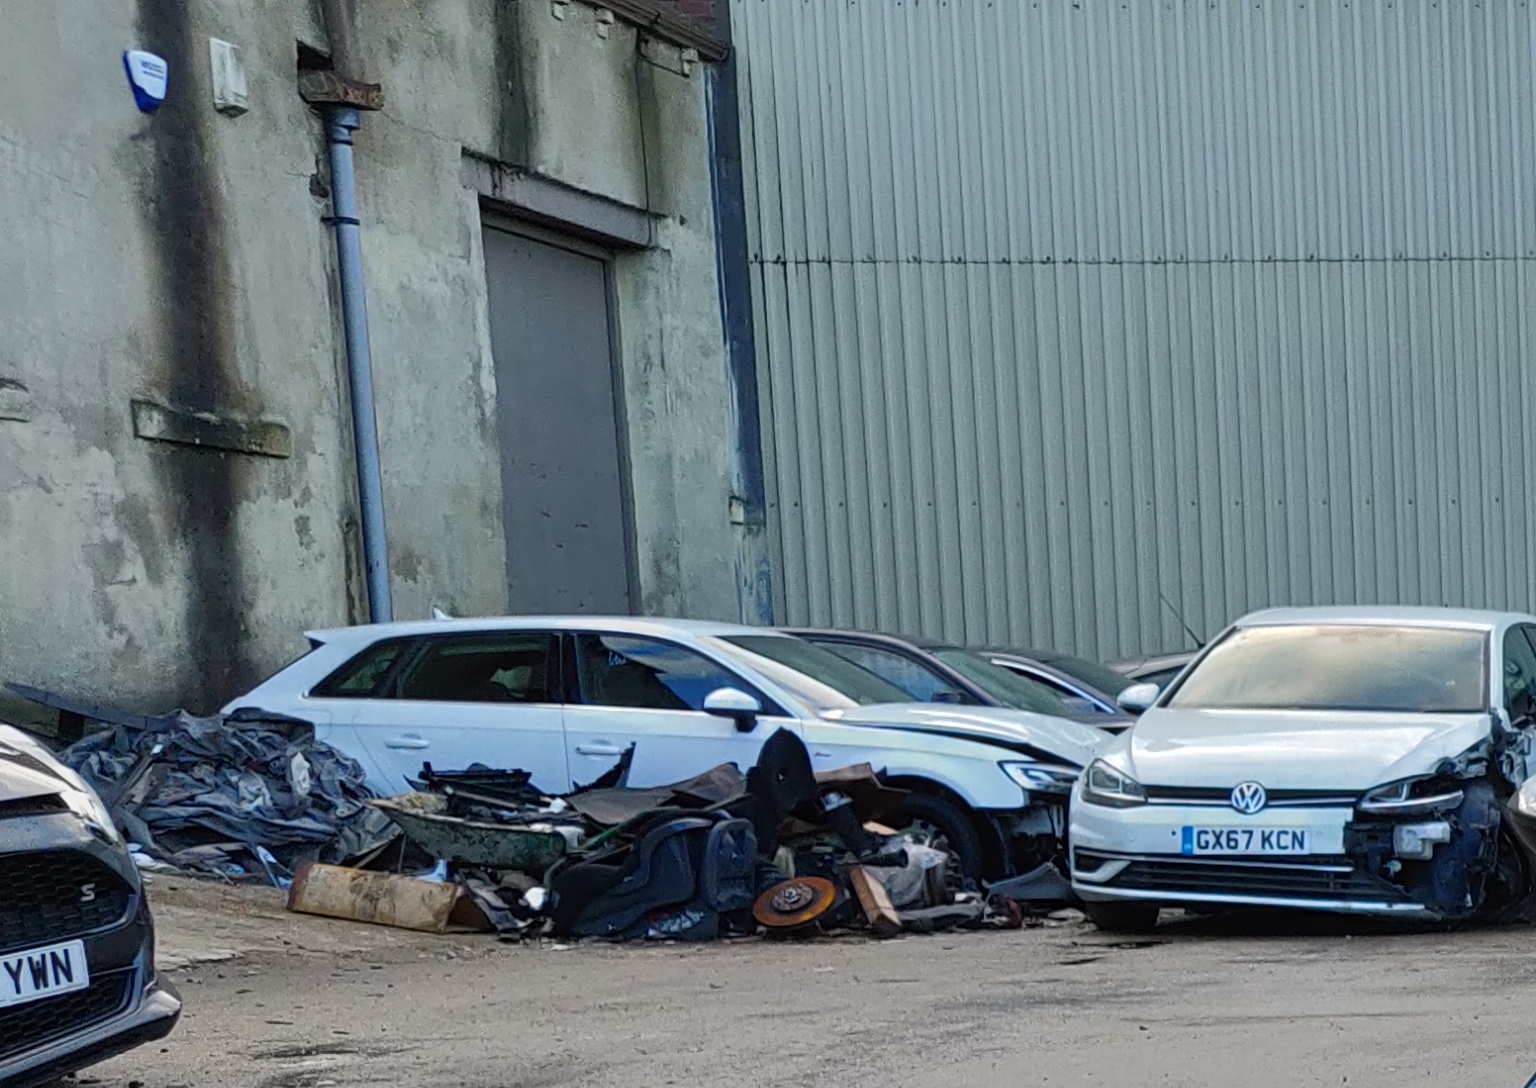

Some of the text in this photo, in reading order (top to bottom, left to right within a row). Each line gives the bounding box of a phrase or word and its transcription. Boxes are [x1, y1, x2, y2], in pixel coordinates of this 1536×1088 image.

[1196, 829, 1306, 851] GX67 KCN
[2, 948, 74, 995] YWN
